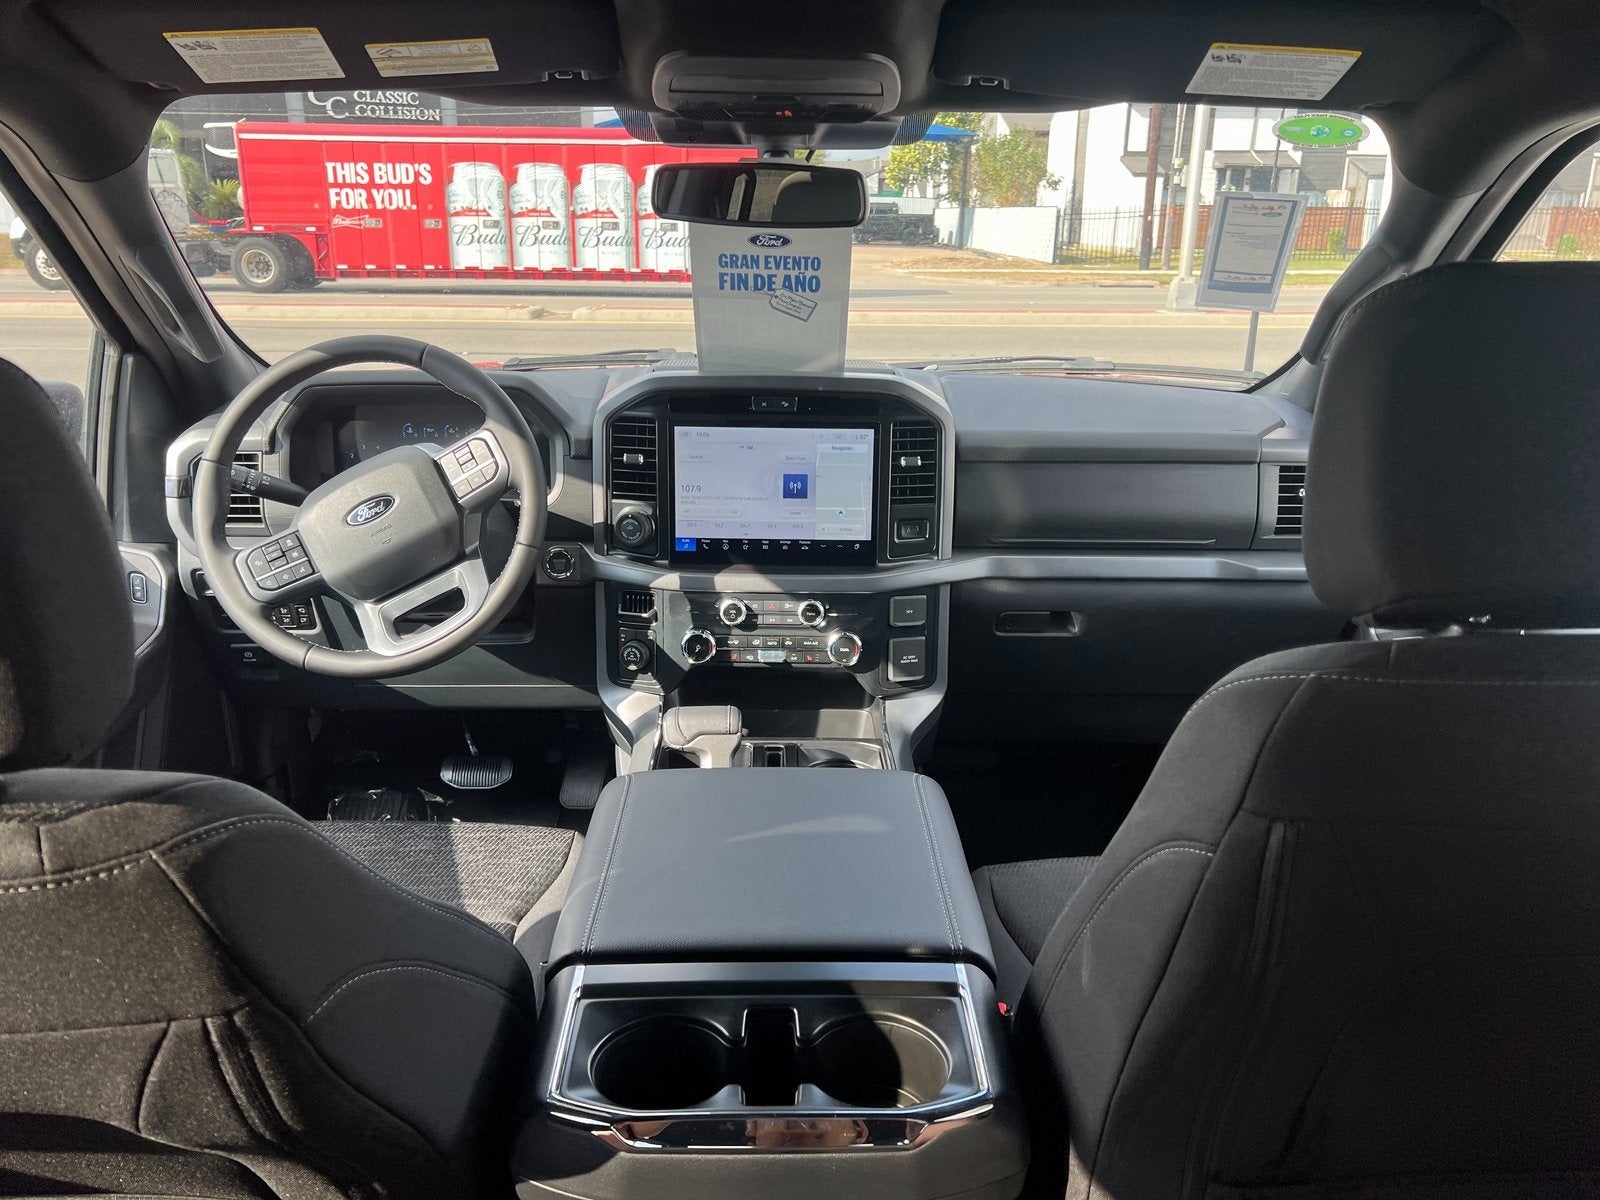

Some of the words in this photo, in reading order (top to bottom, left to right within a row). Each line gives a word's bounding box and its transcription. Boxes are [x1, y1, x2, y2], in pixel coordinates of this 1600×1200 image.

[353, 90, 419, 105] CLASSIC
[355, 104, 441, 121] COLLISION
[325, 162, 370, 184] THIS
[373, 162, 433, 185] BUD'S
[329, 188, 369, 210] FOR
[371, 188, 417, 211] YOU.
[756, 234, 784, 247] Ford
[718, 253, 760, 270] GRAN
[764, 255, 822, 272] EVENTO
[718, 272, 749, 291] FIN
[753, 273, 778, 292] DE
[782, 271, 821, 294] AÑO
[681, 484, 702, 493] 107.9
[357, 501, 385, 522] Ford
